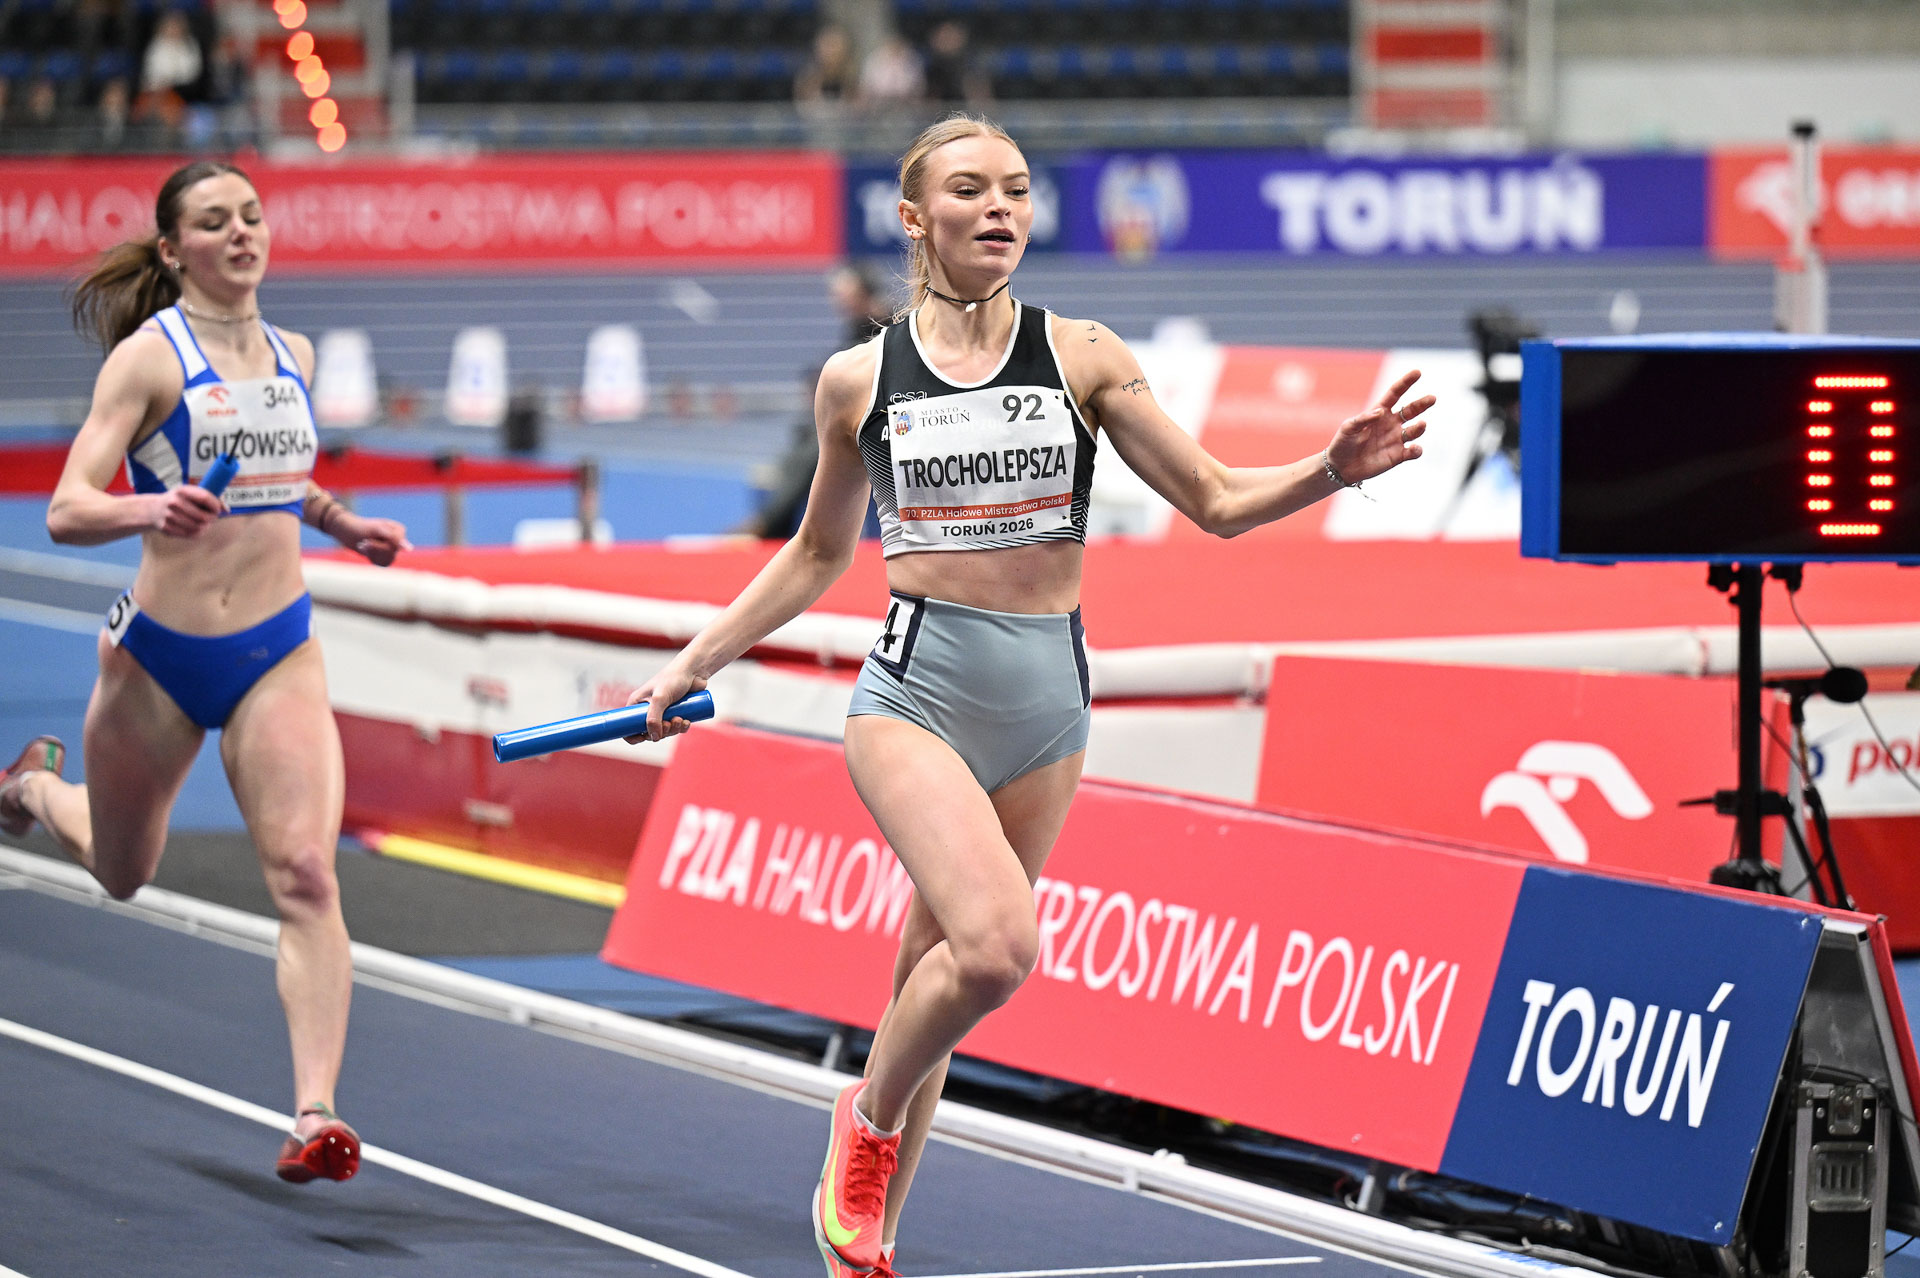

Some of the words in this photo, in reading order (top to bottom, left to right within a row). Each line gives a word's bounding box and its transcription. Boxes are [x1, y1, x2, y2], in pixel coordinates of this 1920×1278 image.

[1260, 154, 1603, 253] TORUŃ
[264, 385, 298, 408] 344
[921, 407, 958, 416] MIASTO
[1002, 394, 1045, 423] 92
[919, 410, 970, 427] TORUŃ
[196, 430, 312, 460] GUZOWSKA
[1808, 376, 1893, 535] 0
[899, 445, 1067, 488] TROCHOLEPSZA
[906, 509, 919, 518] 70.
[921, 509, 944, 518] PZLA
[947, 508, 982, 518] Halowe
[985, 500, 1038, 516] Mistrzostwa
[1040, 495, 1065, 509] Polski
[941, 521, 996, 537] TORUŃ
[1000, 518, 1034, 534] 2026
[882, 602, 899, 654] 4
[659, 803, 761, 906] PZLA
[754, 824, 914, 940] HALOW
[1262, 930, 1459, 1065] POLSKI
[1507, 979, 1735, 1128] TORUŃ
